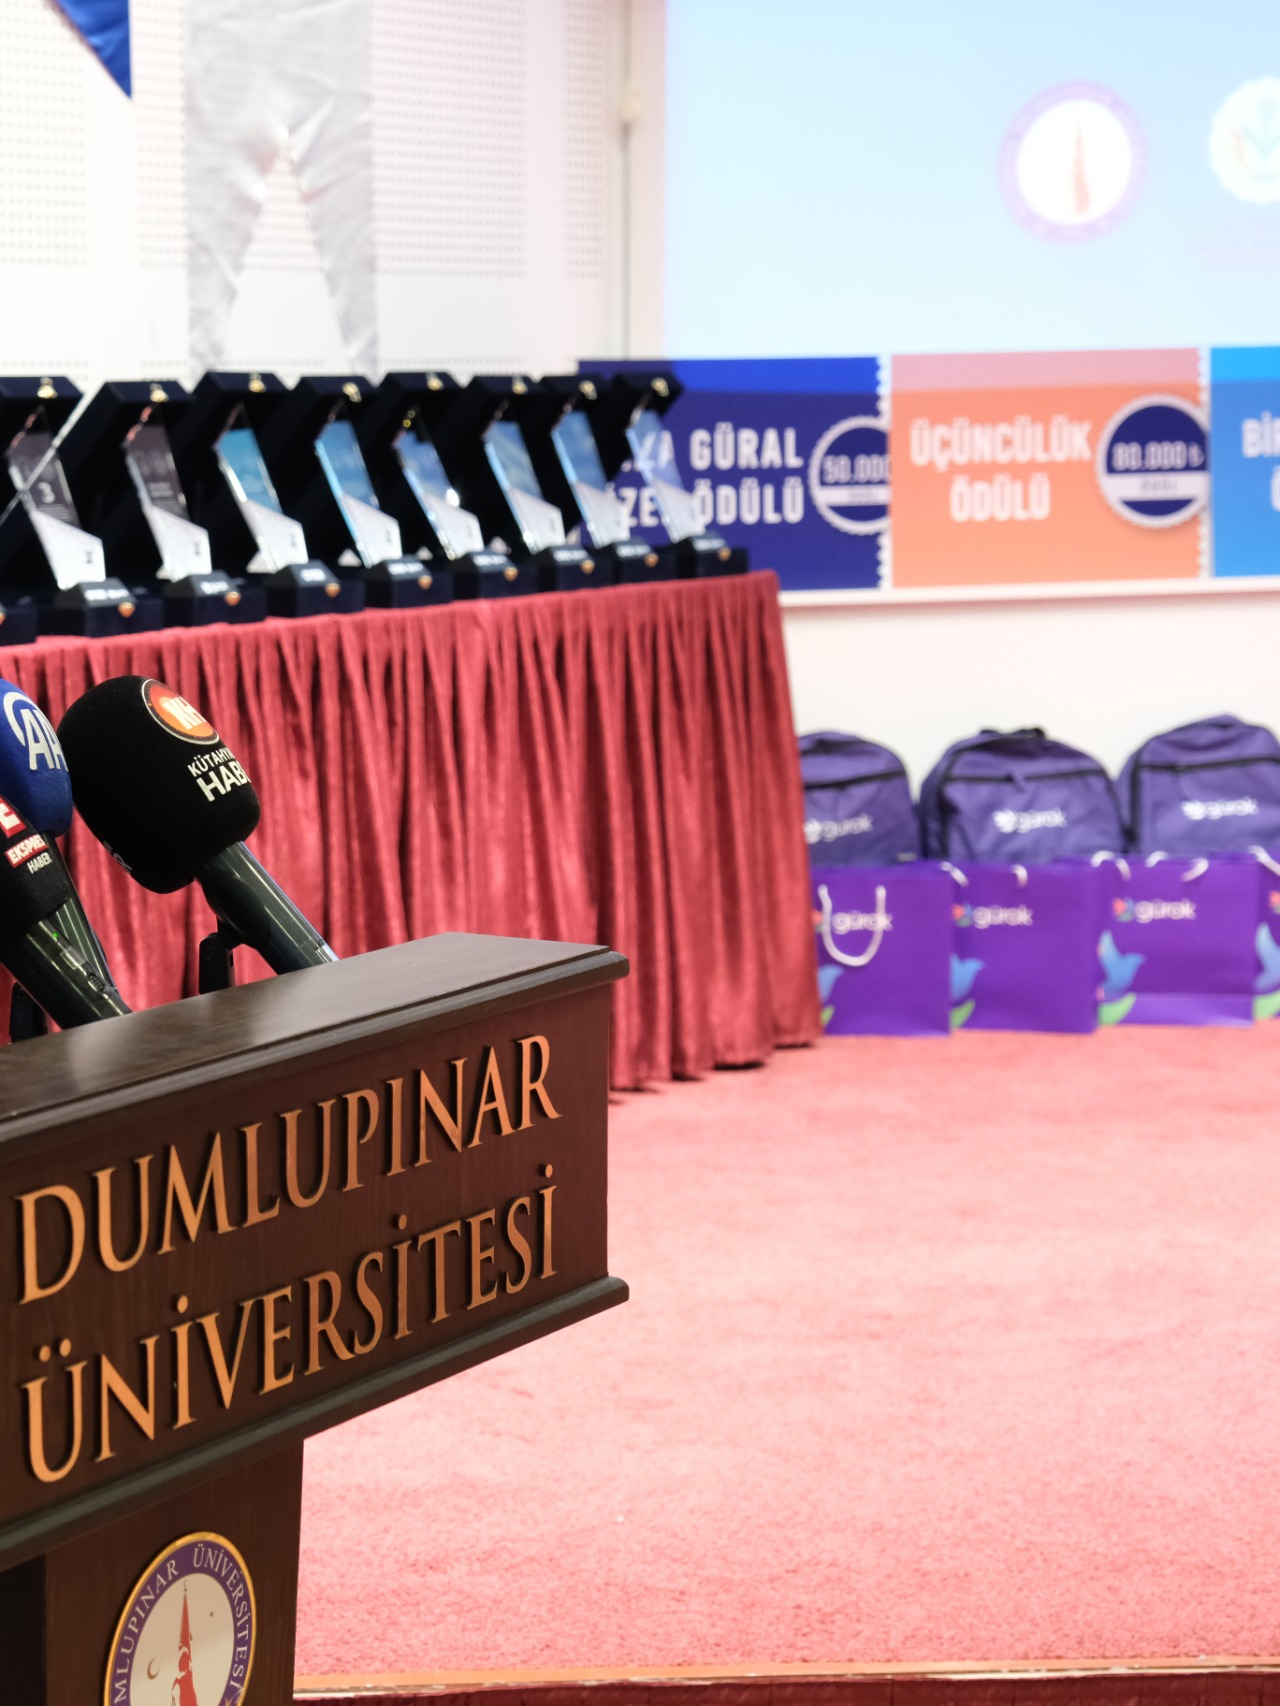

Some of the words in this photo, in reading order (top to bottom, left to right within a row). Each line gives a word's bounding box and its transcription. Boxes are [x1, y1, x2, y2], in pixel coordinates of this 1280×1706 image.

[688, 421, 804, 471] GÜRAL
[910, 414, 1093, 472] ÜÇÜNCÜLÜK
[693, 476, 805, 526] ÖDÜLÜ
[950, 472, 1051, 523] ÖDÜLÜ
[16, 1034, 563, 1304] DUMLUPINAR
[22, 1164, 557, 1483] ÜNİVERSİTESİ
